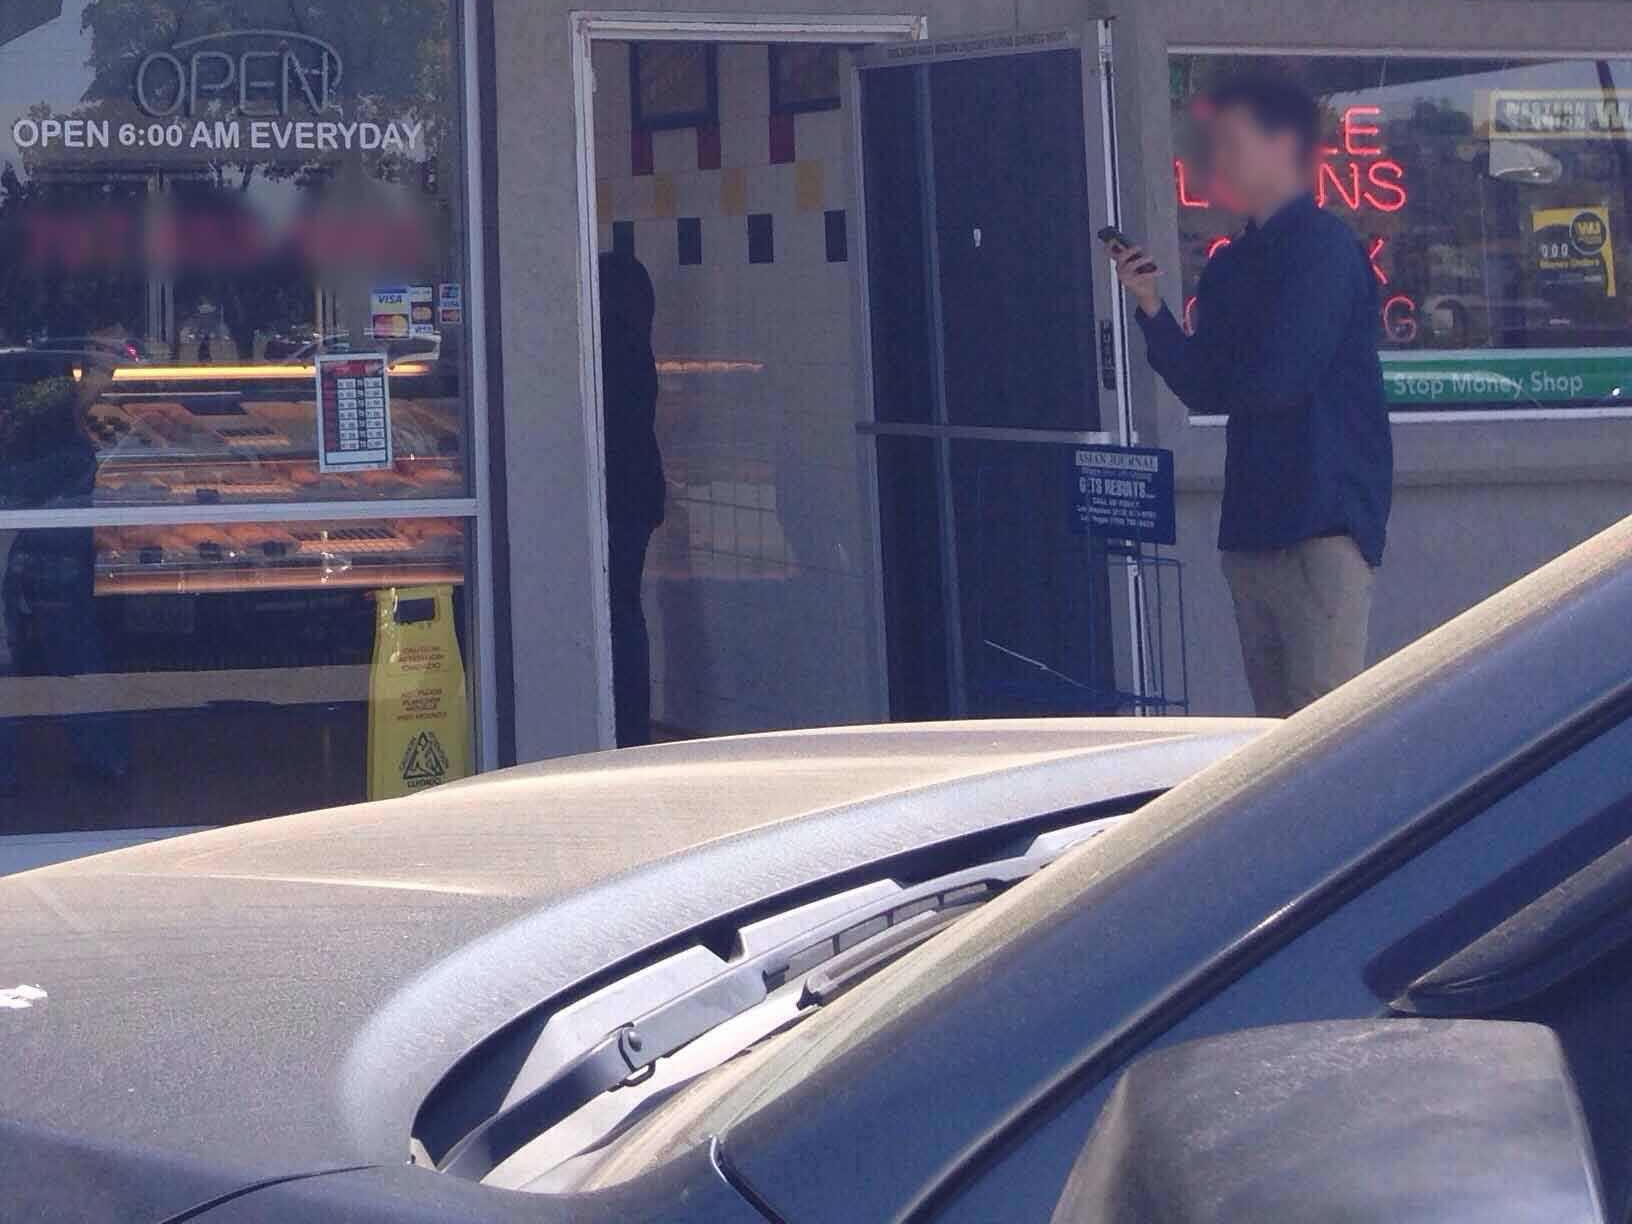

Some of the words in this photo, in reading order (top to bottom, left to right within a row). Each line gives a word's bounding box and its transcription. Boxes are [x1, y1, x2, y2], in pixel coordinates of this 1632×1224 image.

[134, 47, 331, 118] OPEN
[12, 119, 110, 149] OPEN
[117, 122, 183, 149] 6:00
[189, 120, 241, 150] AM
[251, 121, 423, 152] EVERYDAY
[1174, 158, 1408, 213] LNS
[378, 294, 403, 304] VISA
[1393, 374, 1444, 399] Stop
[1452, 371, 1524, 399] Money
[1530, 369, 1585, 399] Shop
[1078, 476, 1103, 494] GTS
